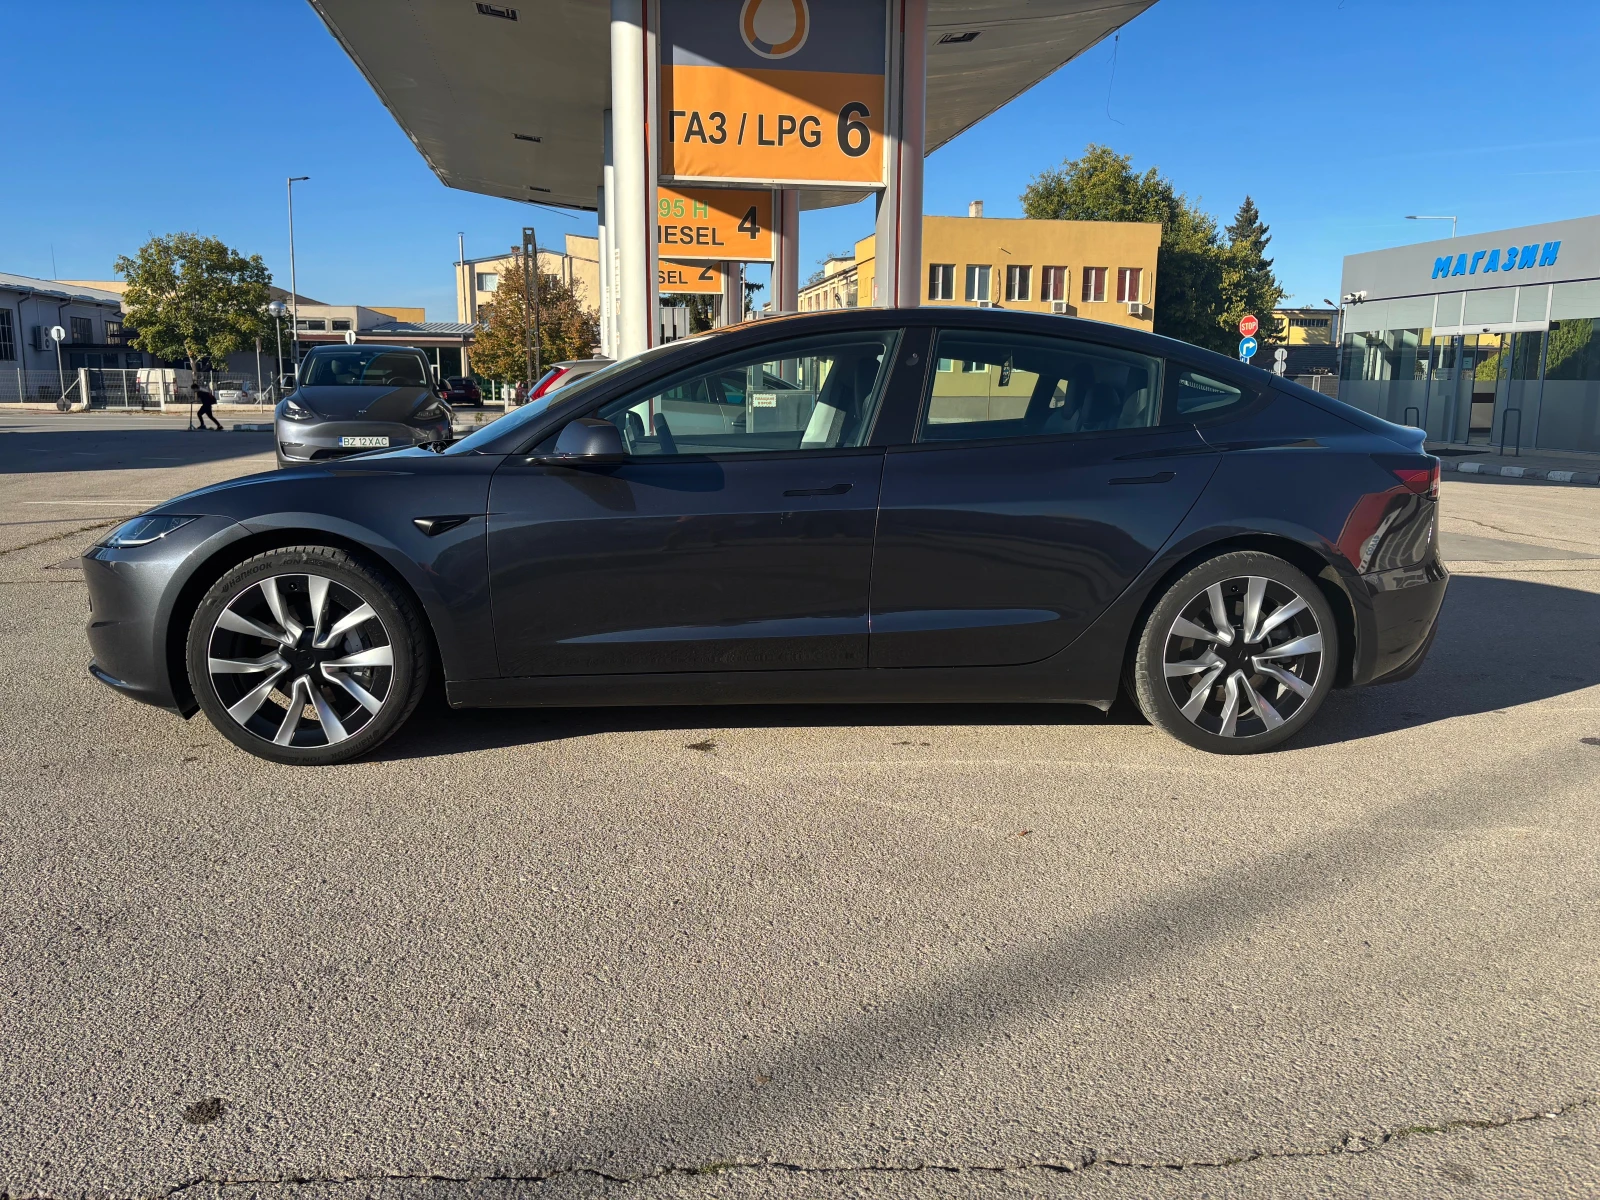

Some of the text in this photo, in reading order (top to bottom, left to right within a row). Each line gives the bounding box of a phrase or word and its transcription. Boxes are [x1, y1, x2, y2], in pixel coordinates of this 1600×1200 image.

[669, 101, 871, 158] ГАЗ / LPG 6
[658, 224, 725, 246] IESEL
[737, 205, 761, 240] 4
[1431, 241, 1562, 279] МАГАЗИН
[659, 270, 689, 285] SEL
[1241, 321, 1257, 331] STOP
